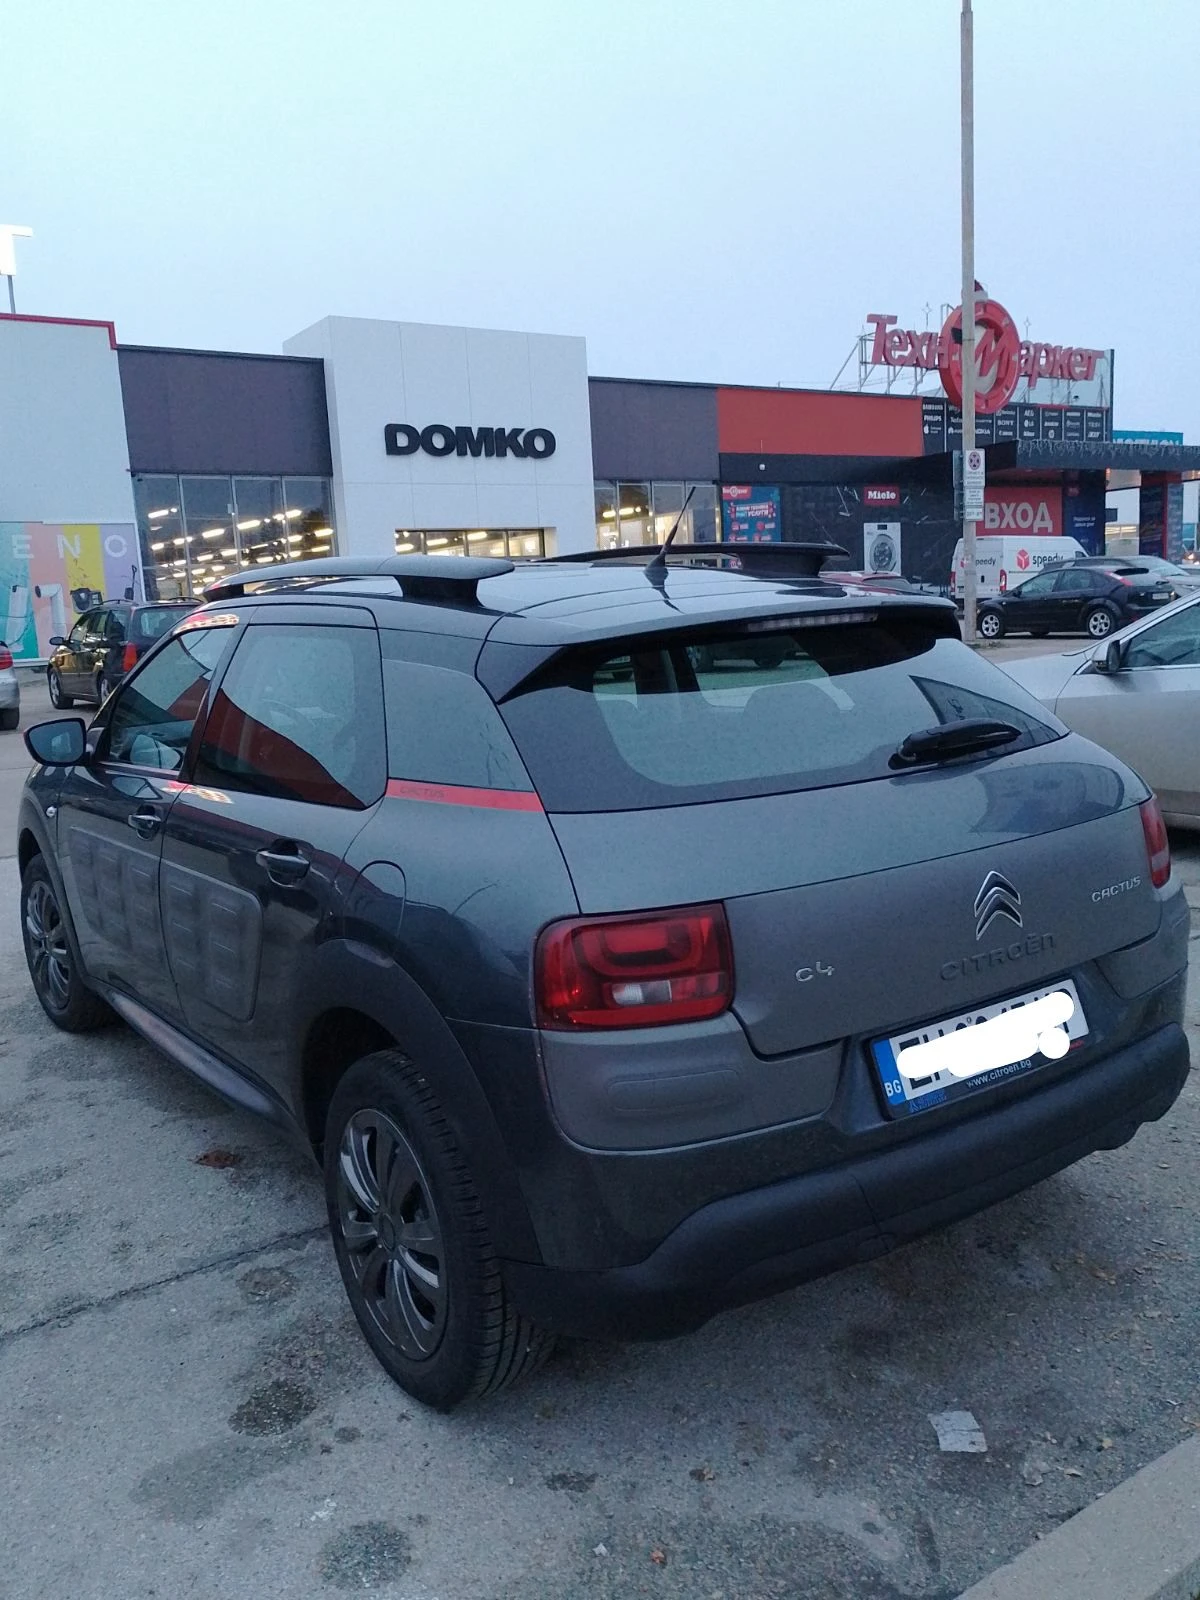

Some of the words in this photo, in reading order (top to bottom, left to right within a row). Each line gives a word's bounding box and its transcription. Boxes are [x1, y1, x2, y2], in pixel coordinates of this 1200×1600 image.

[384, 423, 556, 459] DOMKO
[867, 490, 896, 500] Miele
[984, 502, 1053, 533] ВХОД
[1091, 875, 1141, 902] CACTUS
[795, 961, 835, 982] C4
[965, 1058, 1032, 1089] www.citroen.bg
[884, 1078, 902, 1098] BG
